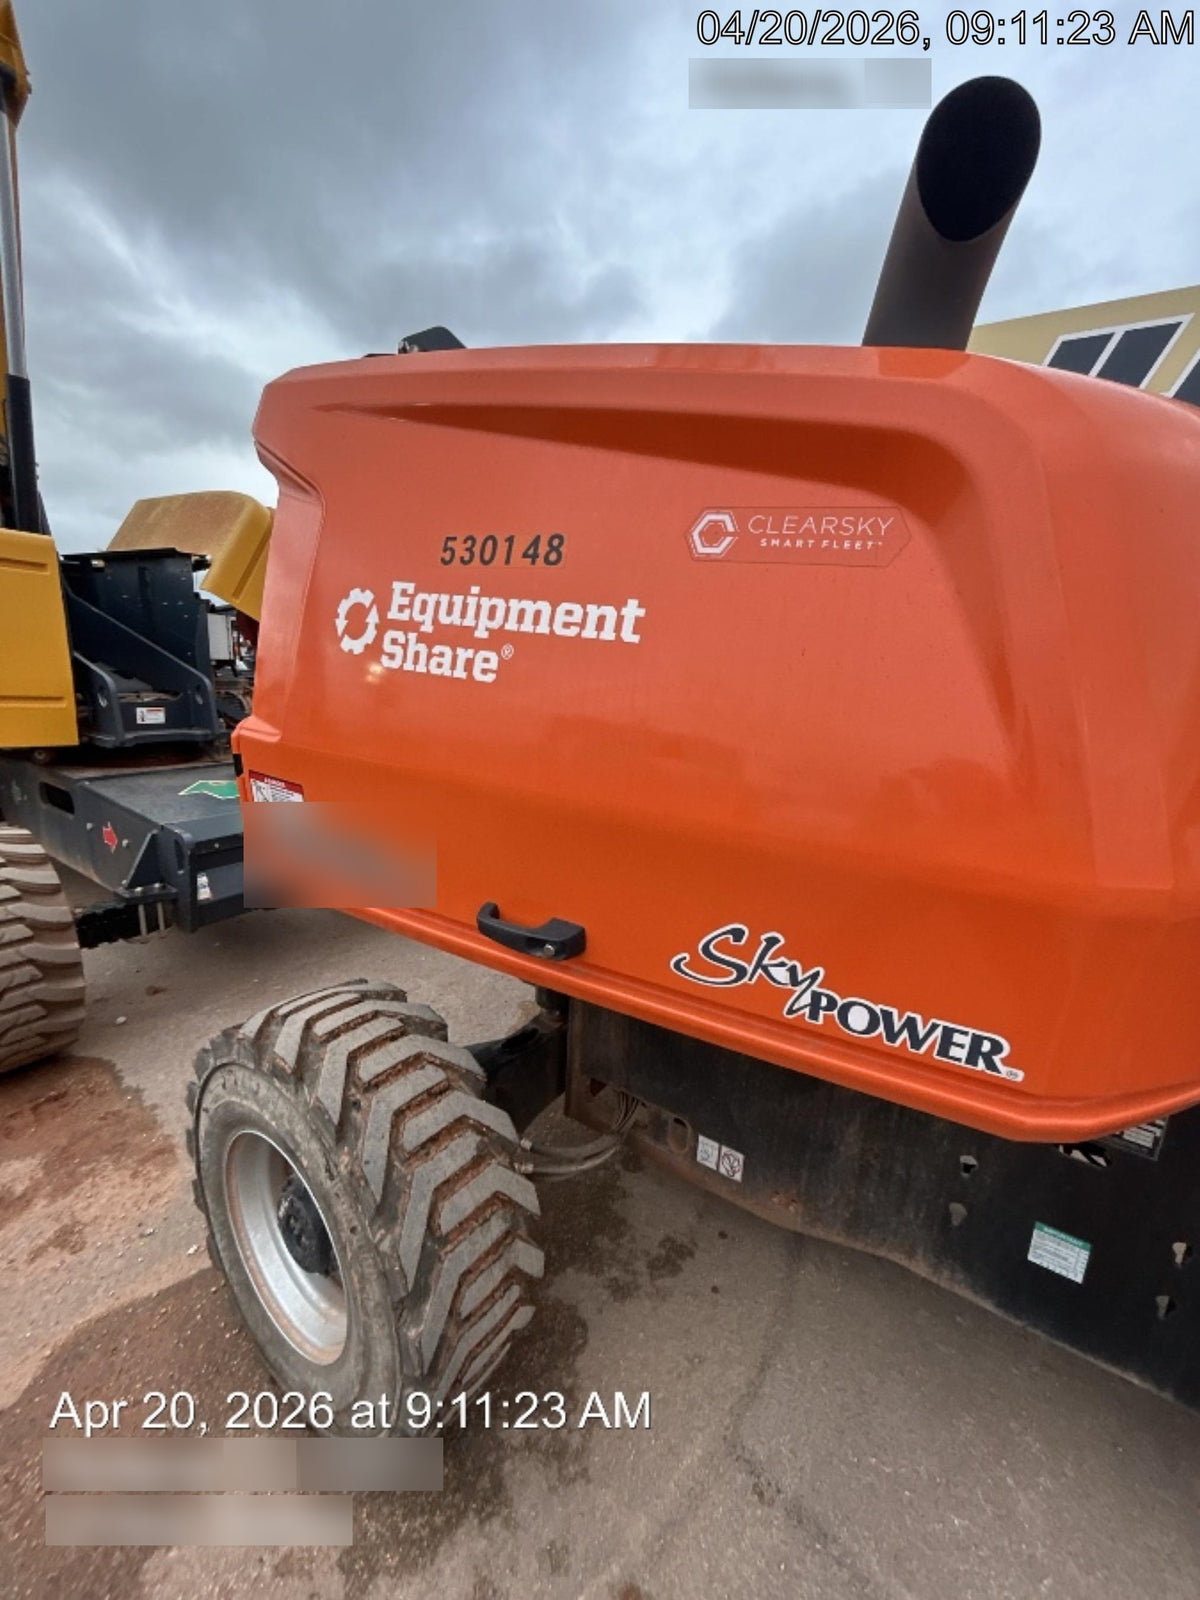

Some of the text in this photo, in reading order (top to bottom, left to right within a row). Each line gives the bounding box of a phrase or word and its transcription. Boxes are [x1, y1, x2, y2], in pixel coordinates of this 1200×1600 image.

[747, 514, 895, 536] CLEARSKY
[440, 533, 565, 566] 530148
[759, 538, 816, 549] SMART
[386, 581, 646, 643] Equipment
